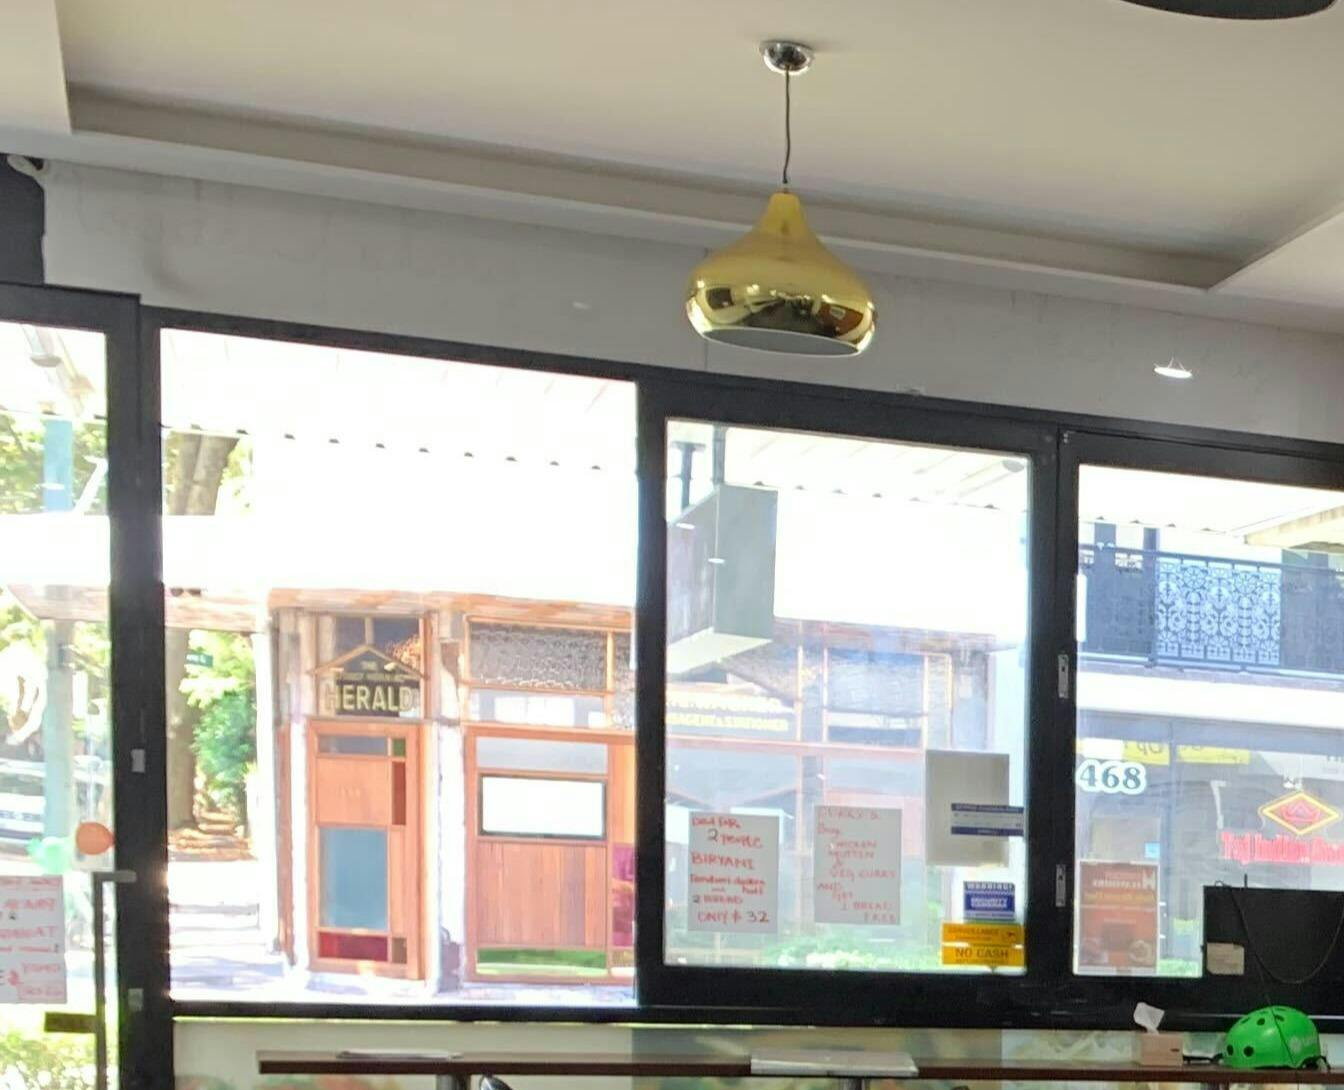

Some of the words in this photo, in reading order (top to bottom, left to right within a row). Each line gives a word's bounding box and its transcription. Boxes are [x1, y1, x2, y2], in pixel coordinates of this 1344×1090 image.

[1080, 764, 1142, 790] 468
[707, 828, 719, 842] 2
[747, 910, 769, 923] 32
[955, 948, 973, 958] NO
[976, 948, 1009, 959] CASH
